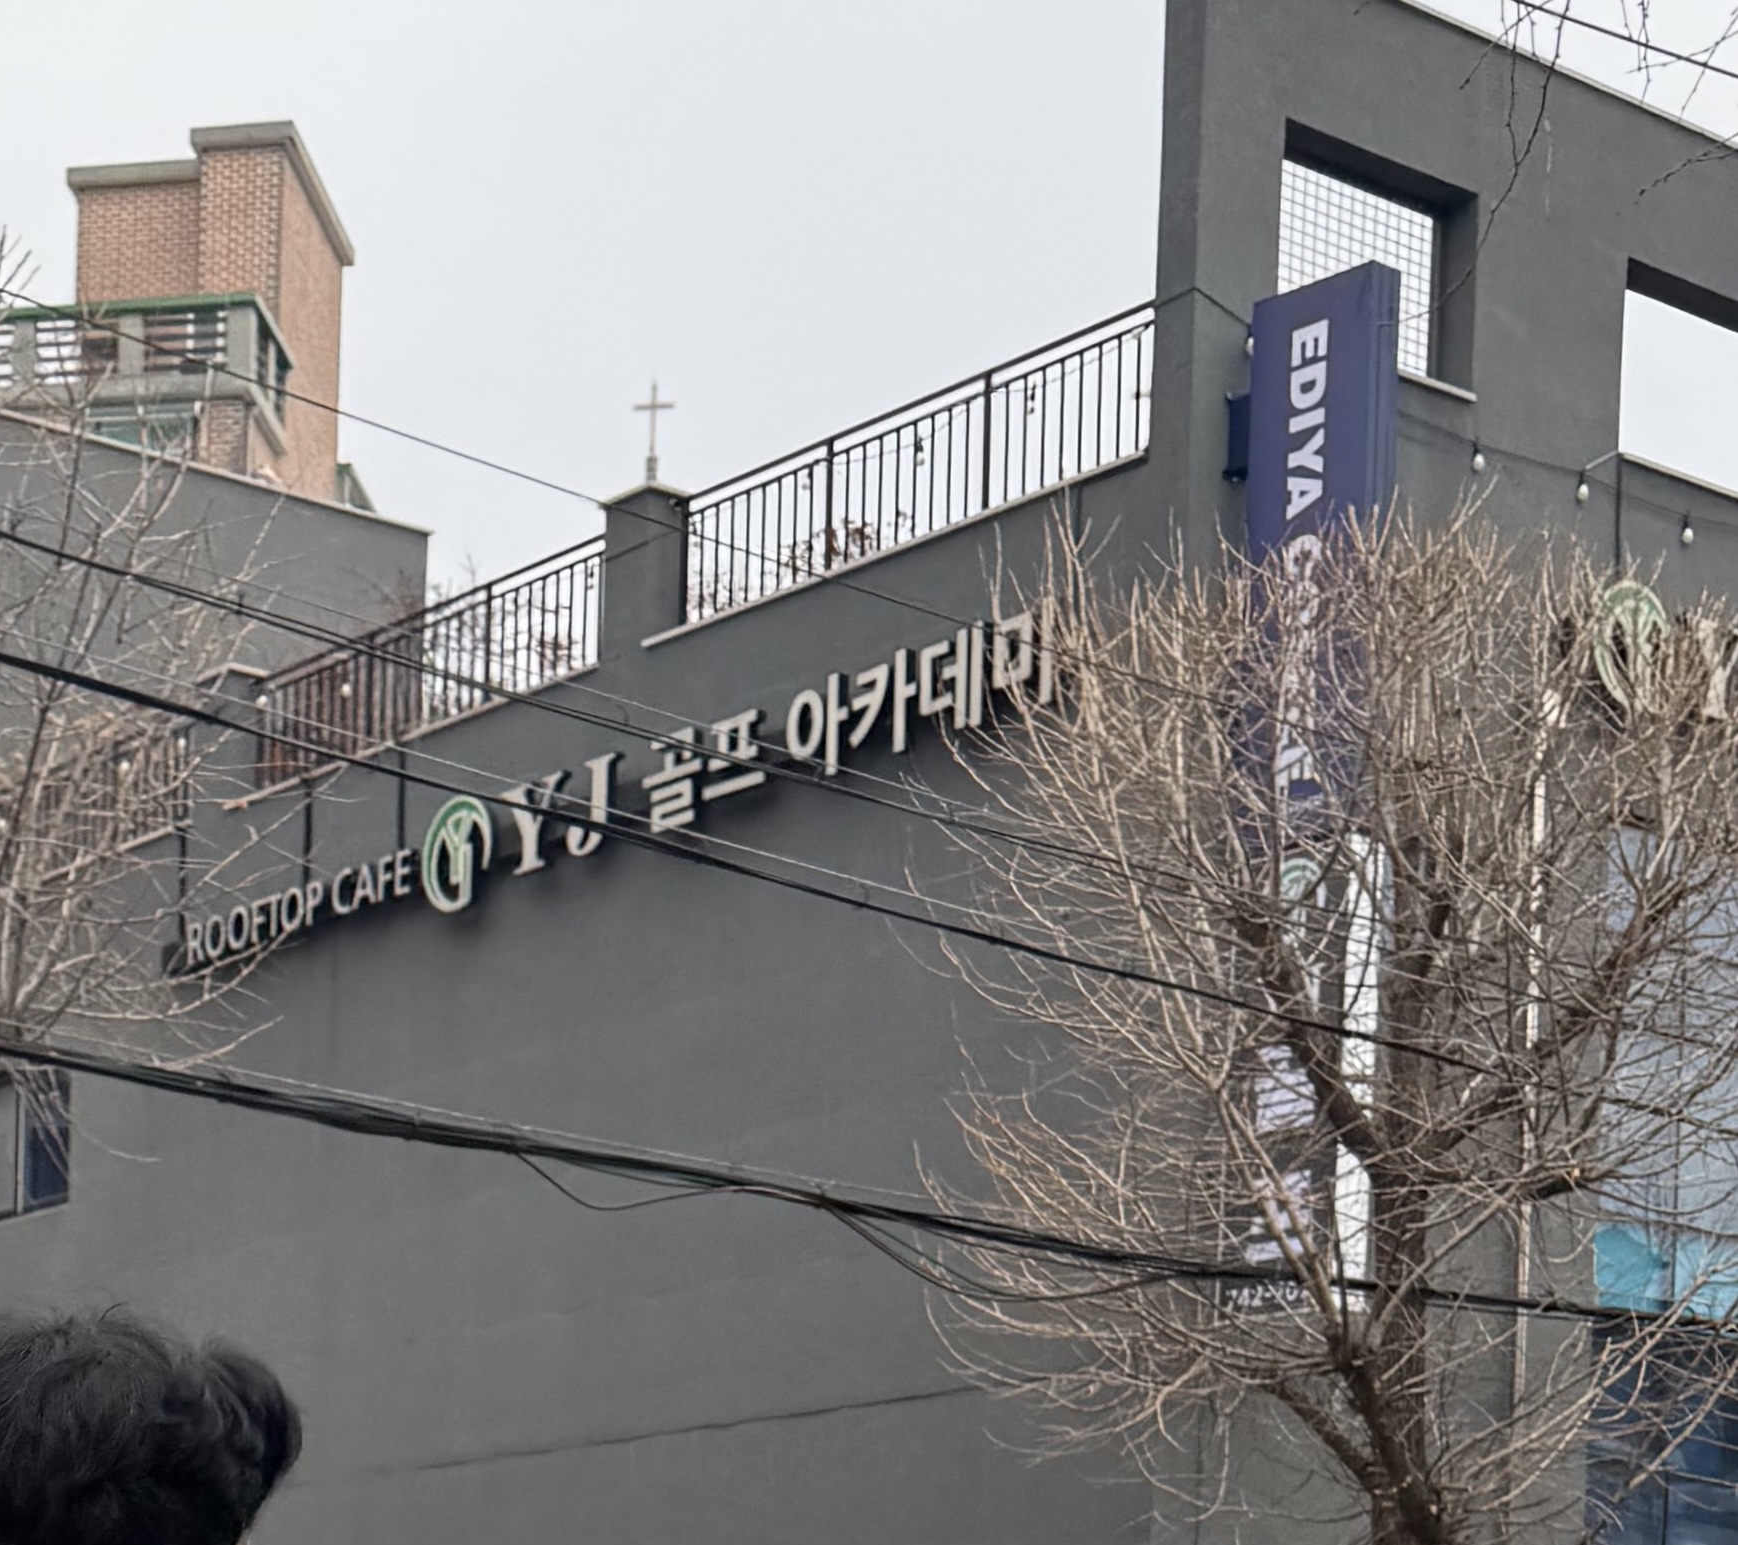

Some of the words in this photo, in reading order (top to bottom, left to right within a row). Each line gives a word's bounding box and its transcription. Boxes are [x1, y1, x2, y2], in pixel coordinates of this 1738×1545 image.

[1285, 318, 1330, 520] EDIYA
[500, 751, 620, 877] YJ
[641, 707, 768, 834] 골프
[784, 598, 1054, 777] 아카데미
[185, 880, 324, 966] ROOFTOP
[331, 848, 412, 915] CAFE
